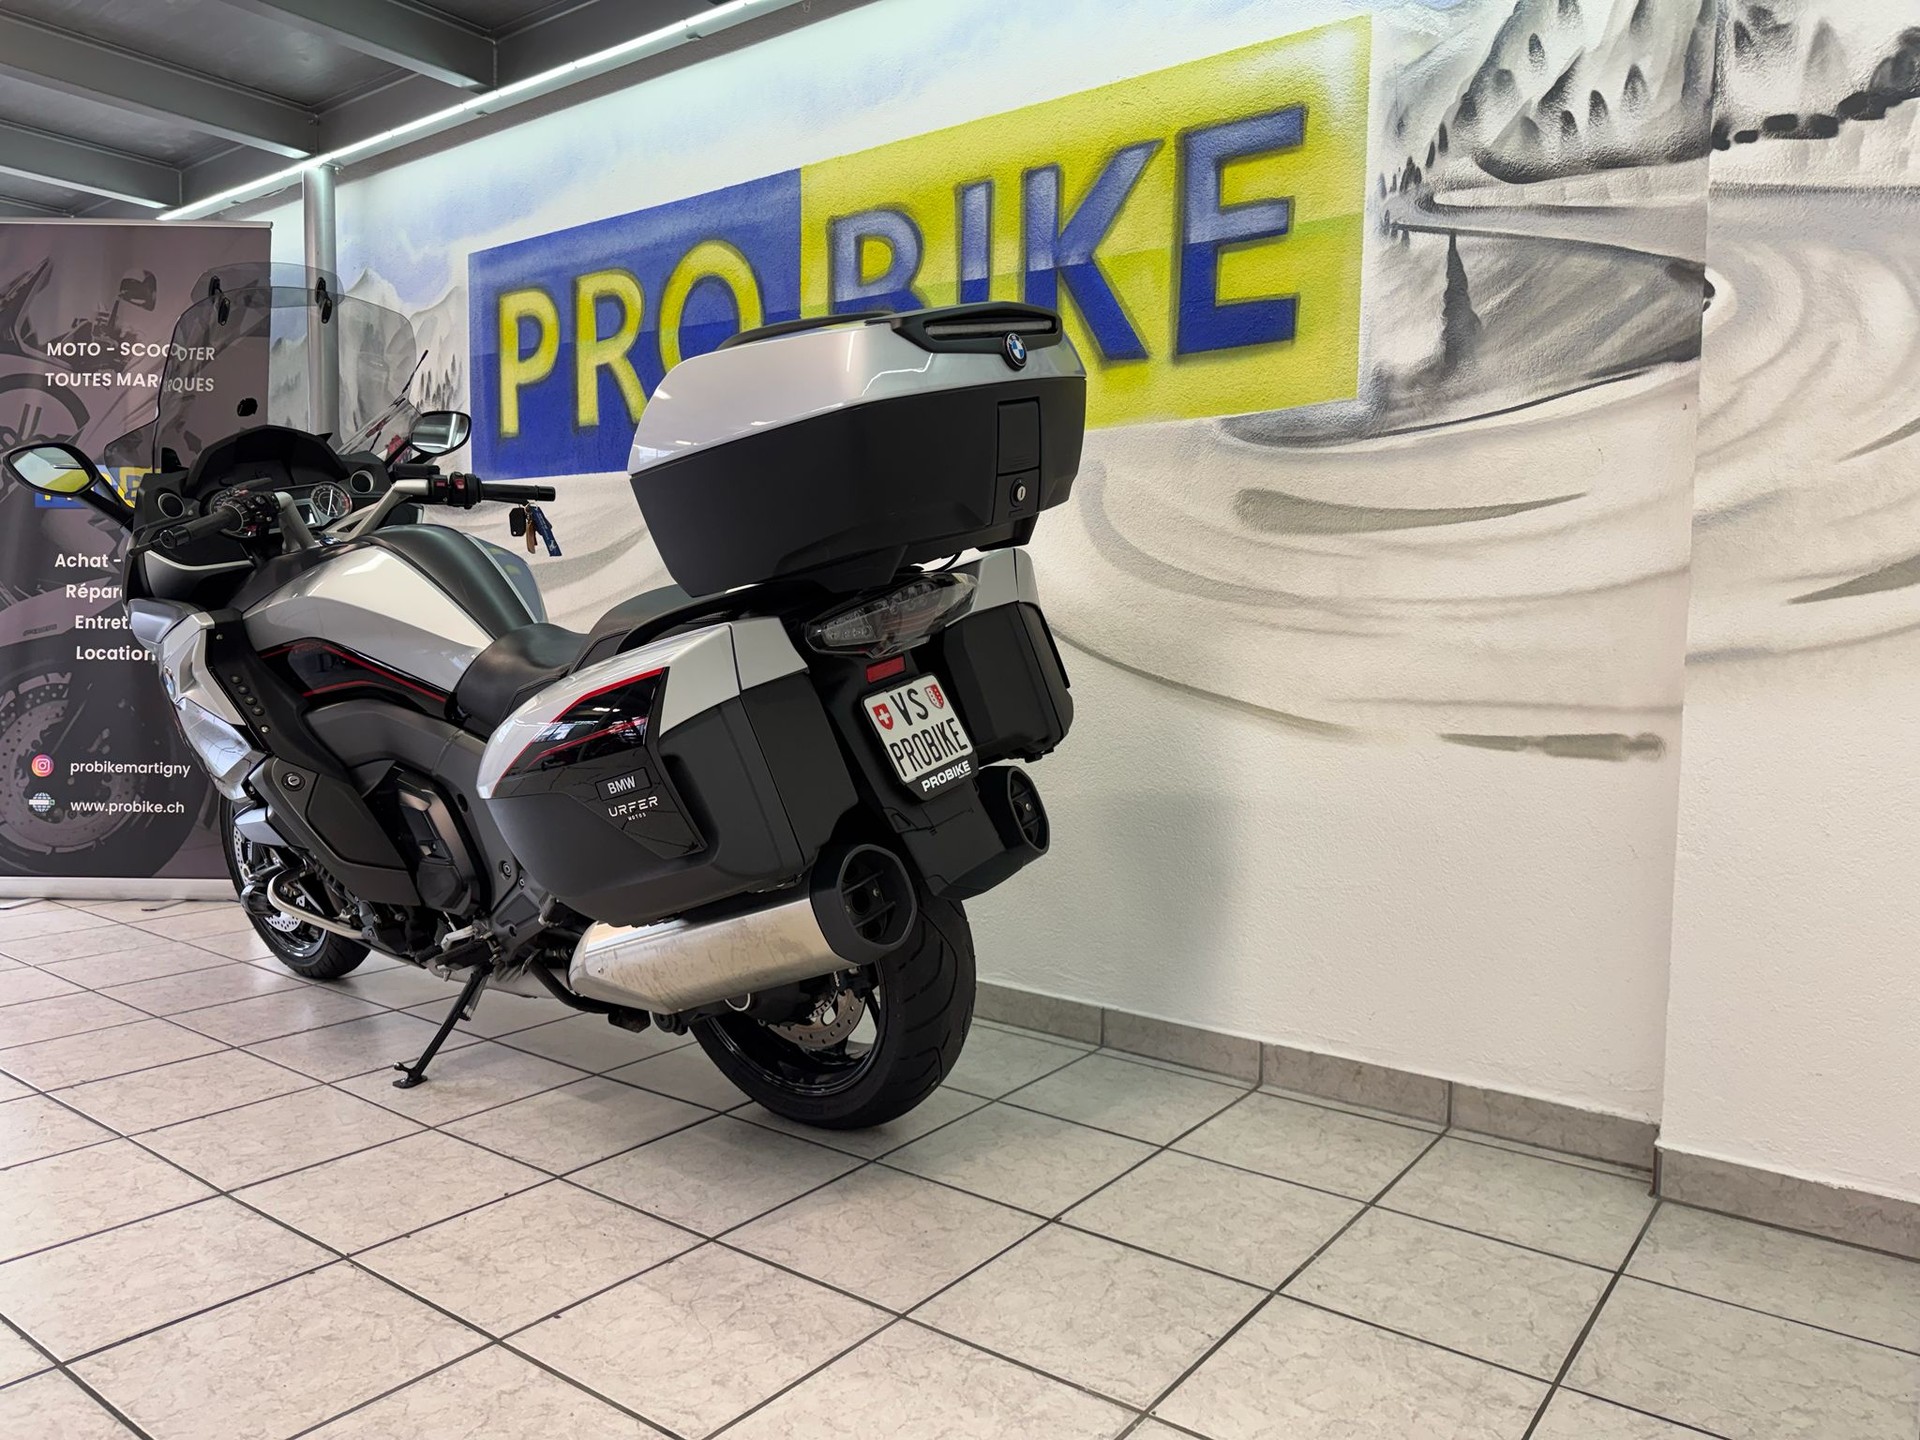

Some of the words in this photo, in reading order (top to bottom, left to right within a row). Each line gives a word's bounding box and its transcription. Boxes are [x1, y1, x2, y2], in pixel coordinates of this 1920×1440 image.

[47, 342, 100, 356] MOTO
[45, 372, 111, 387] TOUTES
[55, 554, 109, 568] Achat
[76, 615, 132, 629] Entret
[890, 688, 928, 726] VS
[889, 718, 968, 776] PROBIKE
[70, 760, 191, 778] probikemartigny
[921, 760, 971, 792] PROBIKE
[607, 776, 636, 794] BMW
[71, 799, 184, 814] www.probike.ch
[608, 796, 658, 817] URFER
